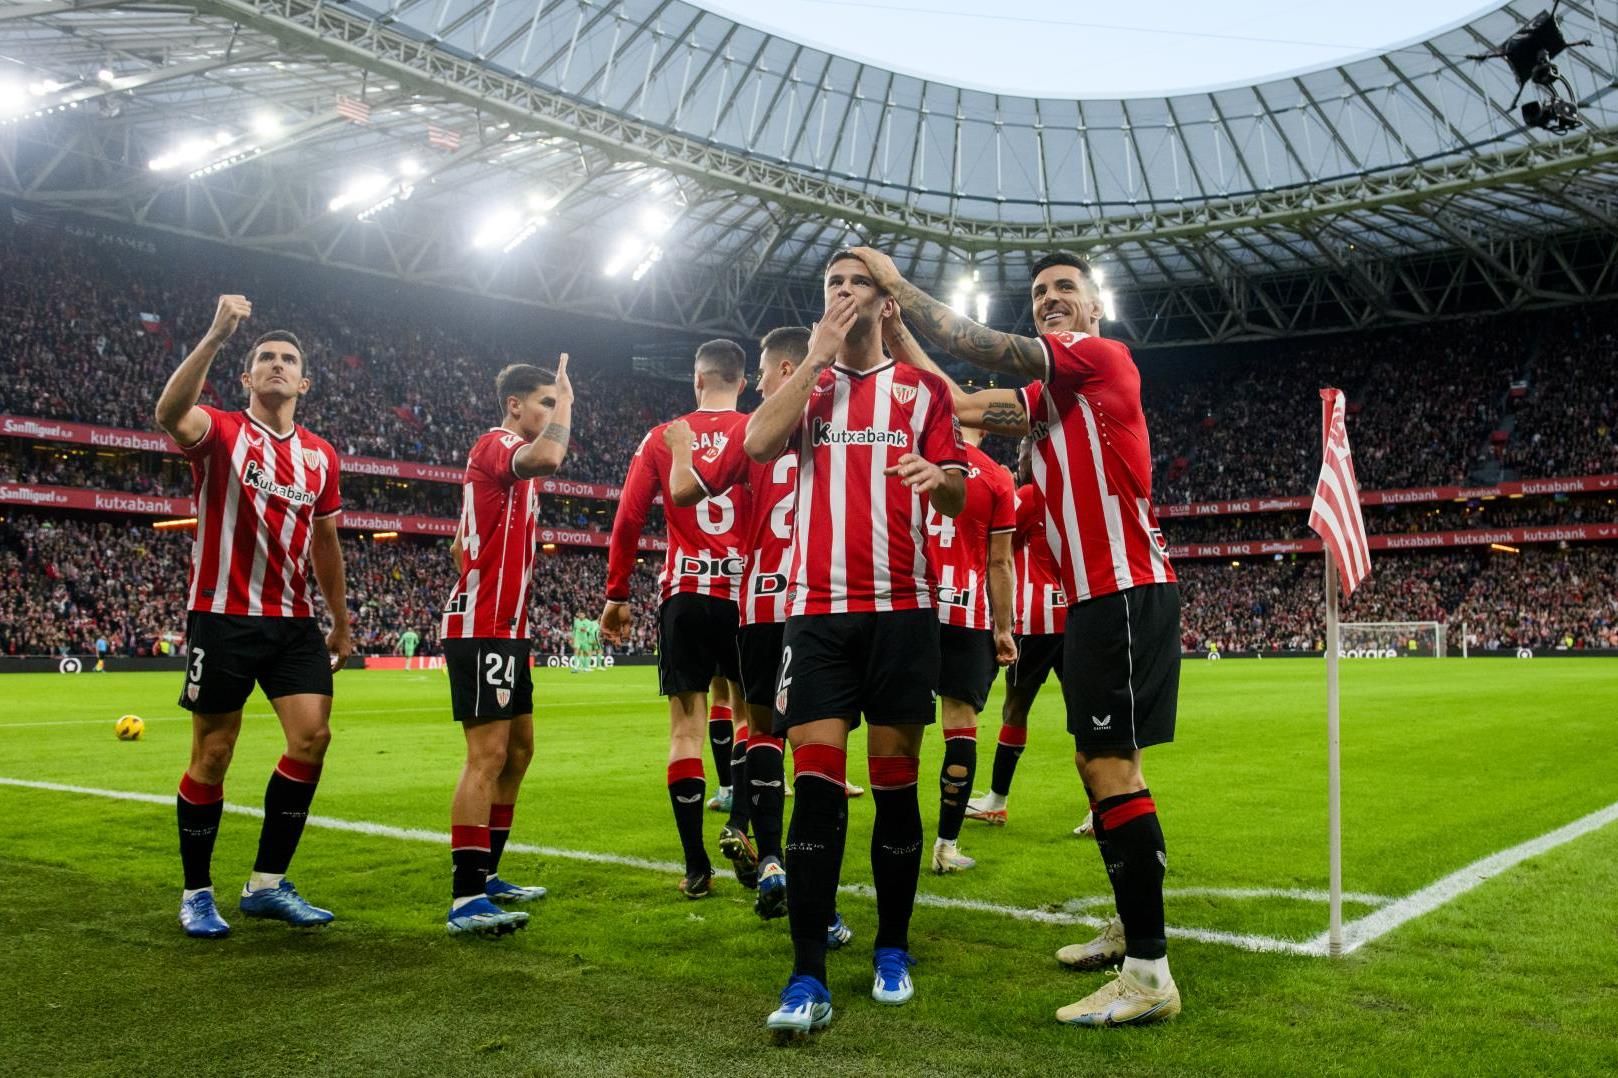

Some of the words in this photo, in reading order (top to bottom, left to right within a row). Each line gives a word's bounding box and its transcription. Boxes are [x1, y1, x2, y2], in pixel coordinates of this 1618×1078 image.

[91, 430, 168, 451] kutxabank
[340, 460, 400, 476] kutxabank
[558, 482, 594, 496] TOYOTA
[1522, 480, 1585, 494] kutxabank
[1382, 489, 1439, 503] kutxabank
[95, 495, 172, 513] kutxabank
[1197, 505, 1219, 514] IMQ
[1228, 502, 1250, 512] IMQ
[343, 515, 402, 530] kutxabank
[556, 532, 592, 543] TOYOTA
[1387, 535, 1444, 547] kutxabank
[1454, 532, 1513, 545] kutxabank
[1524, 528, 1586, 541] kutxabank
[1198, 546, 1221, 556] IMQ
[1228, 545, 1250, 555] IMQ
[189, 647, 205, 682] 3
[561, 655, 615, 668] soae
[485, 652, 515, 688] 24
